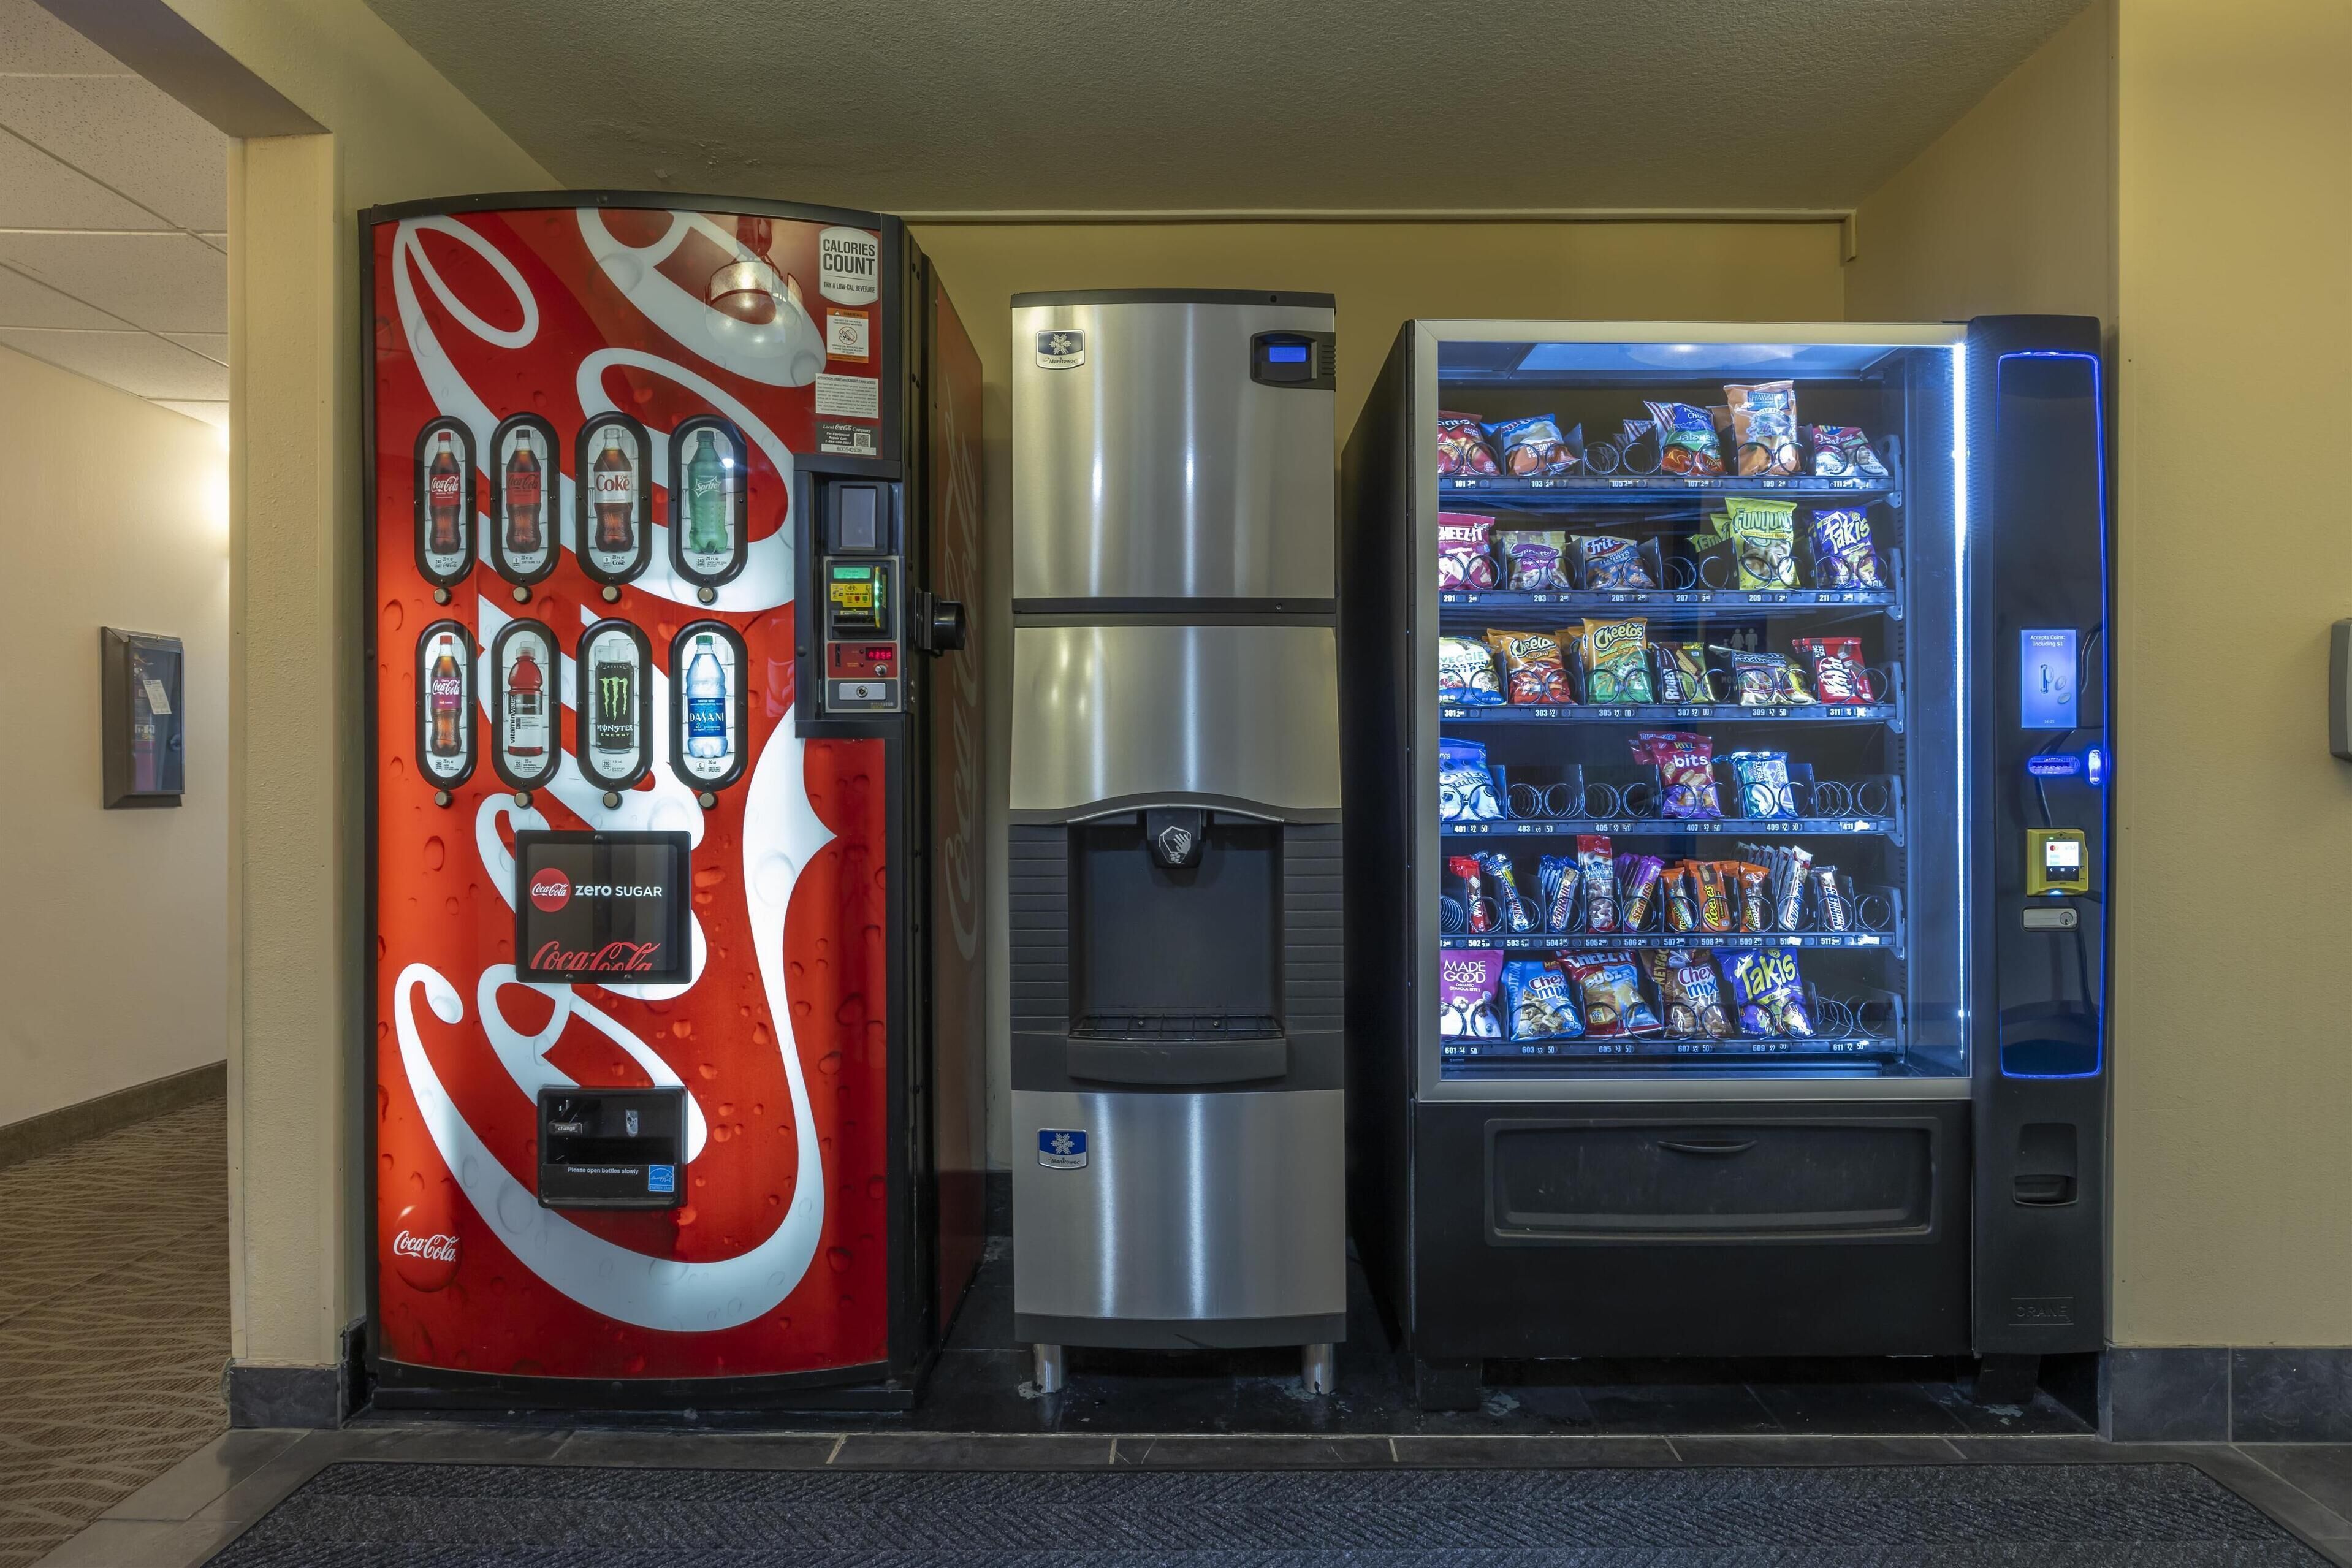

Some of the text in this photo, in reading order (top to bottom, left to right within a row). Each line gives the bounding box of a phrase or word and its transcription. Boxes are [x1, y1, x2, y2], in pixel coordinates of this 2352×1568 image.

[823, 239, 875, 257] CALORIES
[823, 253, 875, 275] COUNT
[432, 476, 460, 493] Coca-Cola
[509, 474, 540, 490] Coca-Cola
[596, 474, 630, 492] Coke
[695, 482, 717, 492] Sprite
[1822, 512, 1870, 554] Takis
[1594, 622, 1645, 650] Cheetos
[1440, 652, 1485, 663] VEGGIE
[1812, 645, 1821, 658] KING
[432, 679, 460, 695] Coca-Cola
[1662, 668, 1680, 699] RUGER
[690, 710, 724, 723] DASANI
[597, 723, 633, 733] MONSTER
[1673, 754, 1709, 768] bits
[1756, 761, 1765, 782] TREATS
[1585, 867, 1613, 877] DIAMOND
[531, 883, 663, 897] Coca-Cola zero SUGAR
[1704, 885, 1719, 927] Reese's
[1444, 959, 1486, 972] MADE
[1443, 970, 1486, 983] GOOD
[1529, 975, 1564, 990] Chex
[1678, 966, 1715, 986] Chex
[1734, 950, 1796, 1002] Takis
[1537, 984, 1566, 1001] mix
[1686, 979, 1720, 999] mix
[393, 1230, 460, 1262] Coca-Cola
[2015, 1306, 2068, 1317] CRANE
